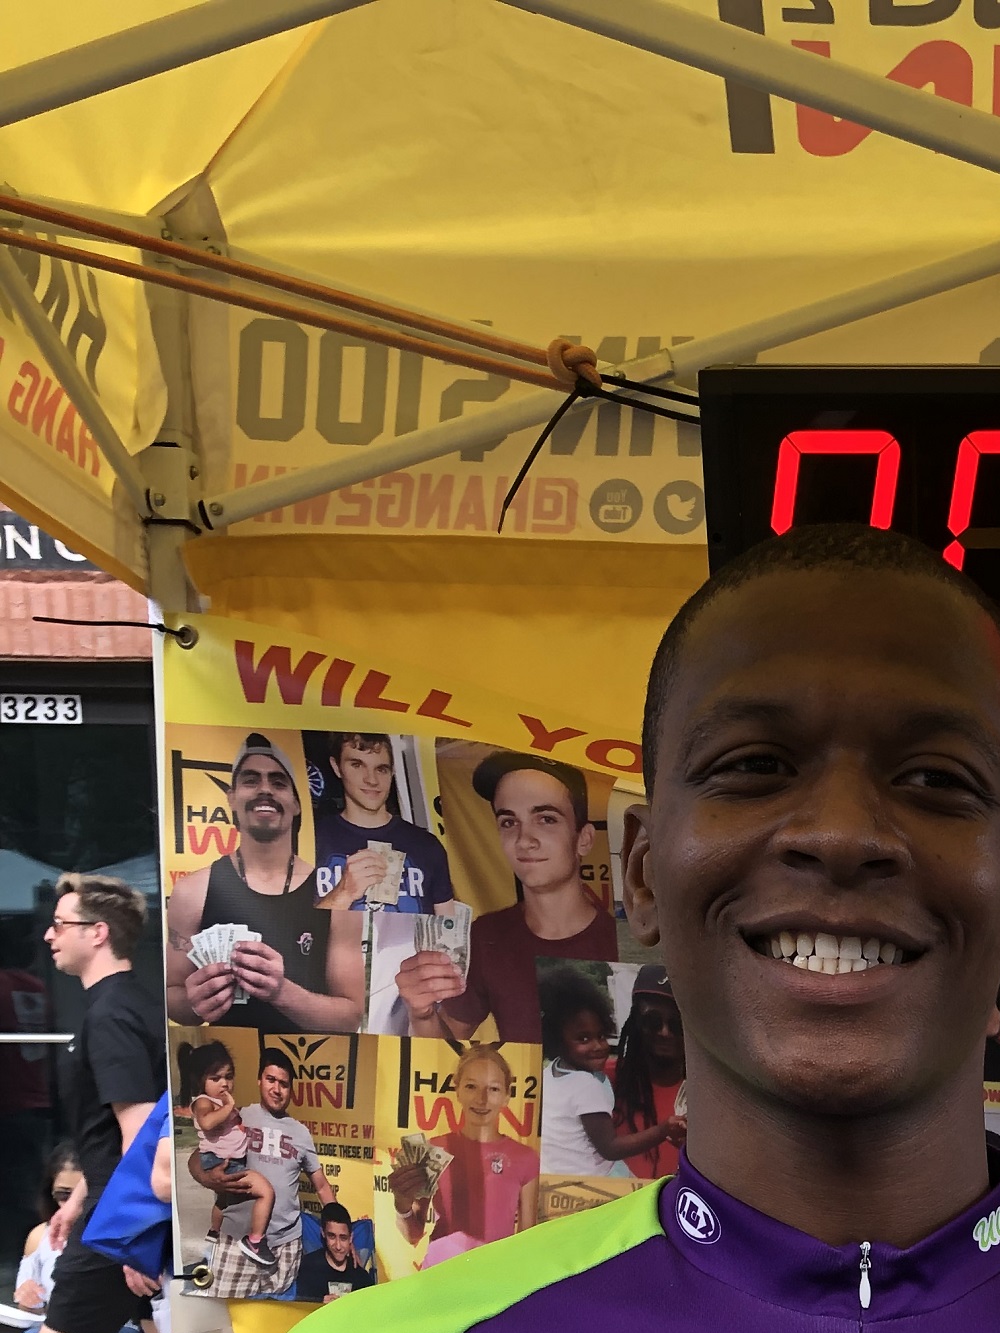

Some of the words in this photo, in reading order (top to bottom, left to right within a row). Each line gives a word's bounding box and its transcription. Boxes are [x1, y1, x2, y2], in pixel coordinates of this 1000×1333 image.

[3, 697, 80, 721] 3233
[234, 639, 474, 728] WILL
[517, 713, 646, 775] YO
[321, 1122, 347, 1139] NEXT
[351, 1124, 359, 1139] 2
[339, 1144, 361, 1159] THESE
[326, 1163, 342, 1177] GRIP
